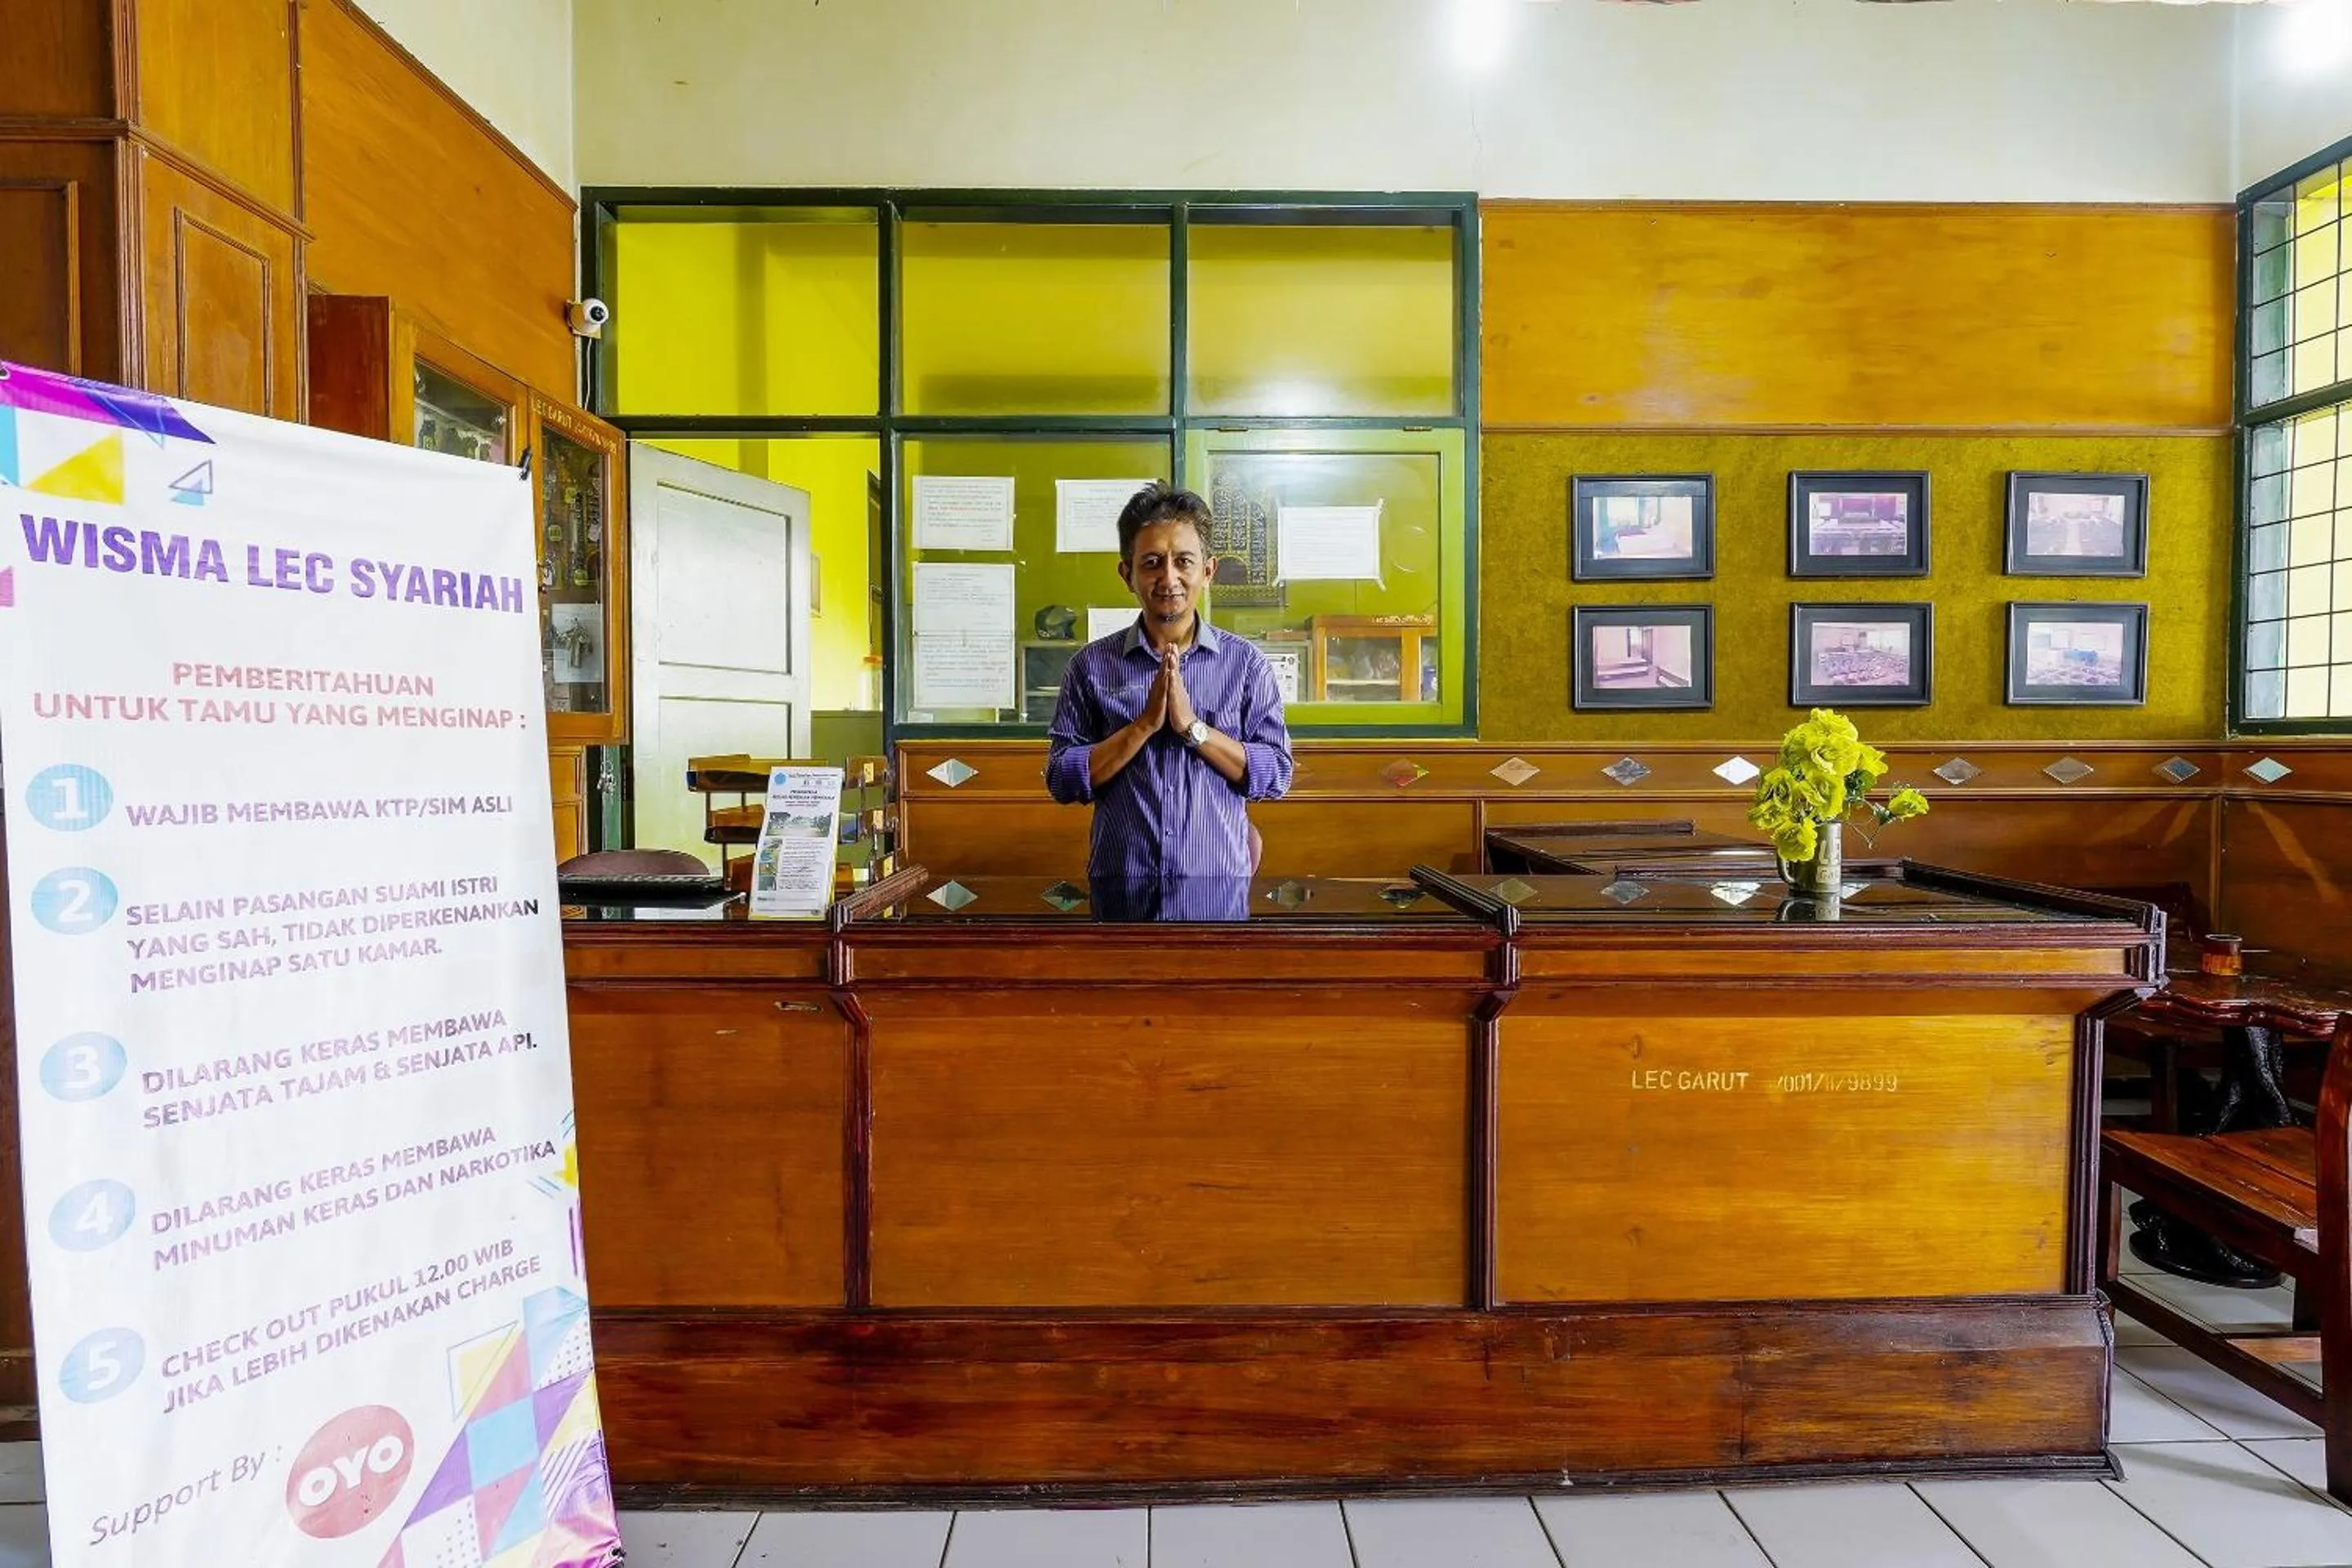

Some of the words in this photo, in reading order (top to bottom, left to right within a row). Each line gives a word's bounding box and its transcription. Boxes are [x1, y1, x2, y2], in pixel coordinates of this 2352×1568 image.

[20, 514, 229, 582] WISMA
[247, 544, 334, 594] LEC
[350, 558, 523, 613] SYARIAH
[33, 693, 169, 721] UNTUK
[177, 699, 275, 724] TAMU
[286, 702, 368, 726] YANG
[376, 705, 514, 728] MENGINAP
[172, 662, 434, 697] PEMBERITAHUAN
[51, 776, 88, 820] 1
[126, 804, 219, 826] WAJIB
[226, 800, 370, 823] MEMBAWA
[375, 796, 466, 818] KTP/SIM
[471, 795, 513, 814] ASLI
[57, 879, 93, 922] 2
[126, 898, 225, 926] SELAIN
[233, 886, 368, 916] PASANGAN
[375, 880, 445, 903] SUAMI
[452, 875, 498, 896] ISTRI
[127, 933, 210, 960] YANG
[217, 926, 277, 950] SAH,
[282, 917, 356, 942] TIDAK
[363, 899, 539, 933] DIPERKENANKAN
[130, 956, 282, 994] MENGINAP
[287, 948, 350, 973] SATU
[358, 938, 443, 964] KAMAR.
[64, 1045, 101, 1090] 3
[141, 1048, 292, 1094] DILARANG
[301, 1031, 381, 1064] KERAS
[387, 1009, 508, 1048] MEMBAWA
[143, 1085, 274, 1129] SENJATA
[280, 1065, 367, 1101] TAJAM
[373, 1061, 392, 1081] &
[397, 1040, 493, 1077] SENJATA
[498, 1032, 538, 1055] API.
[1631, 1070, 1673, 1089] LEC
[1677, 1071, 1750, 1091] GARUT
[75, 1191, 114, 1236] 4
[151, 1180, 292, 1235] DILARANG
[300, 1157, 376, 1194] KERAS
[381, 1126, 497, 1172] MEMBAWA
[154, 1211, 296, 1272] MINUMAN
[303, 1187, 379, 1226] KERAS
[385, 1173, 434, 1203] DAN
[439, 1141, 556, 1184] NARKOTIKA
[86, 1340, 122, 1392] 5
[162, 1326, 260, 1379] CHECK
[265, 1303, 322, 1340] OUT
[329, 1276, 410, 1318] PUKUL
[414, 1254, 470, 1288] 12.00
[474, 1238, 514, 1266] WIB
[163, 1374, 225, 1414] JIKA
[231, 1340, 309, 1387] LEBIH
[316, 1288, 450, 1355] DIKENAKAN
[457, 1254, 541, 1300] CHARGE
[89, 1469, 221, 1547] Support
[231, 1451, 266, 1482] By
[299, 1434, 404, 1508] OYO
